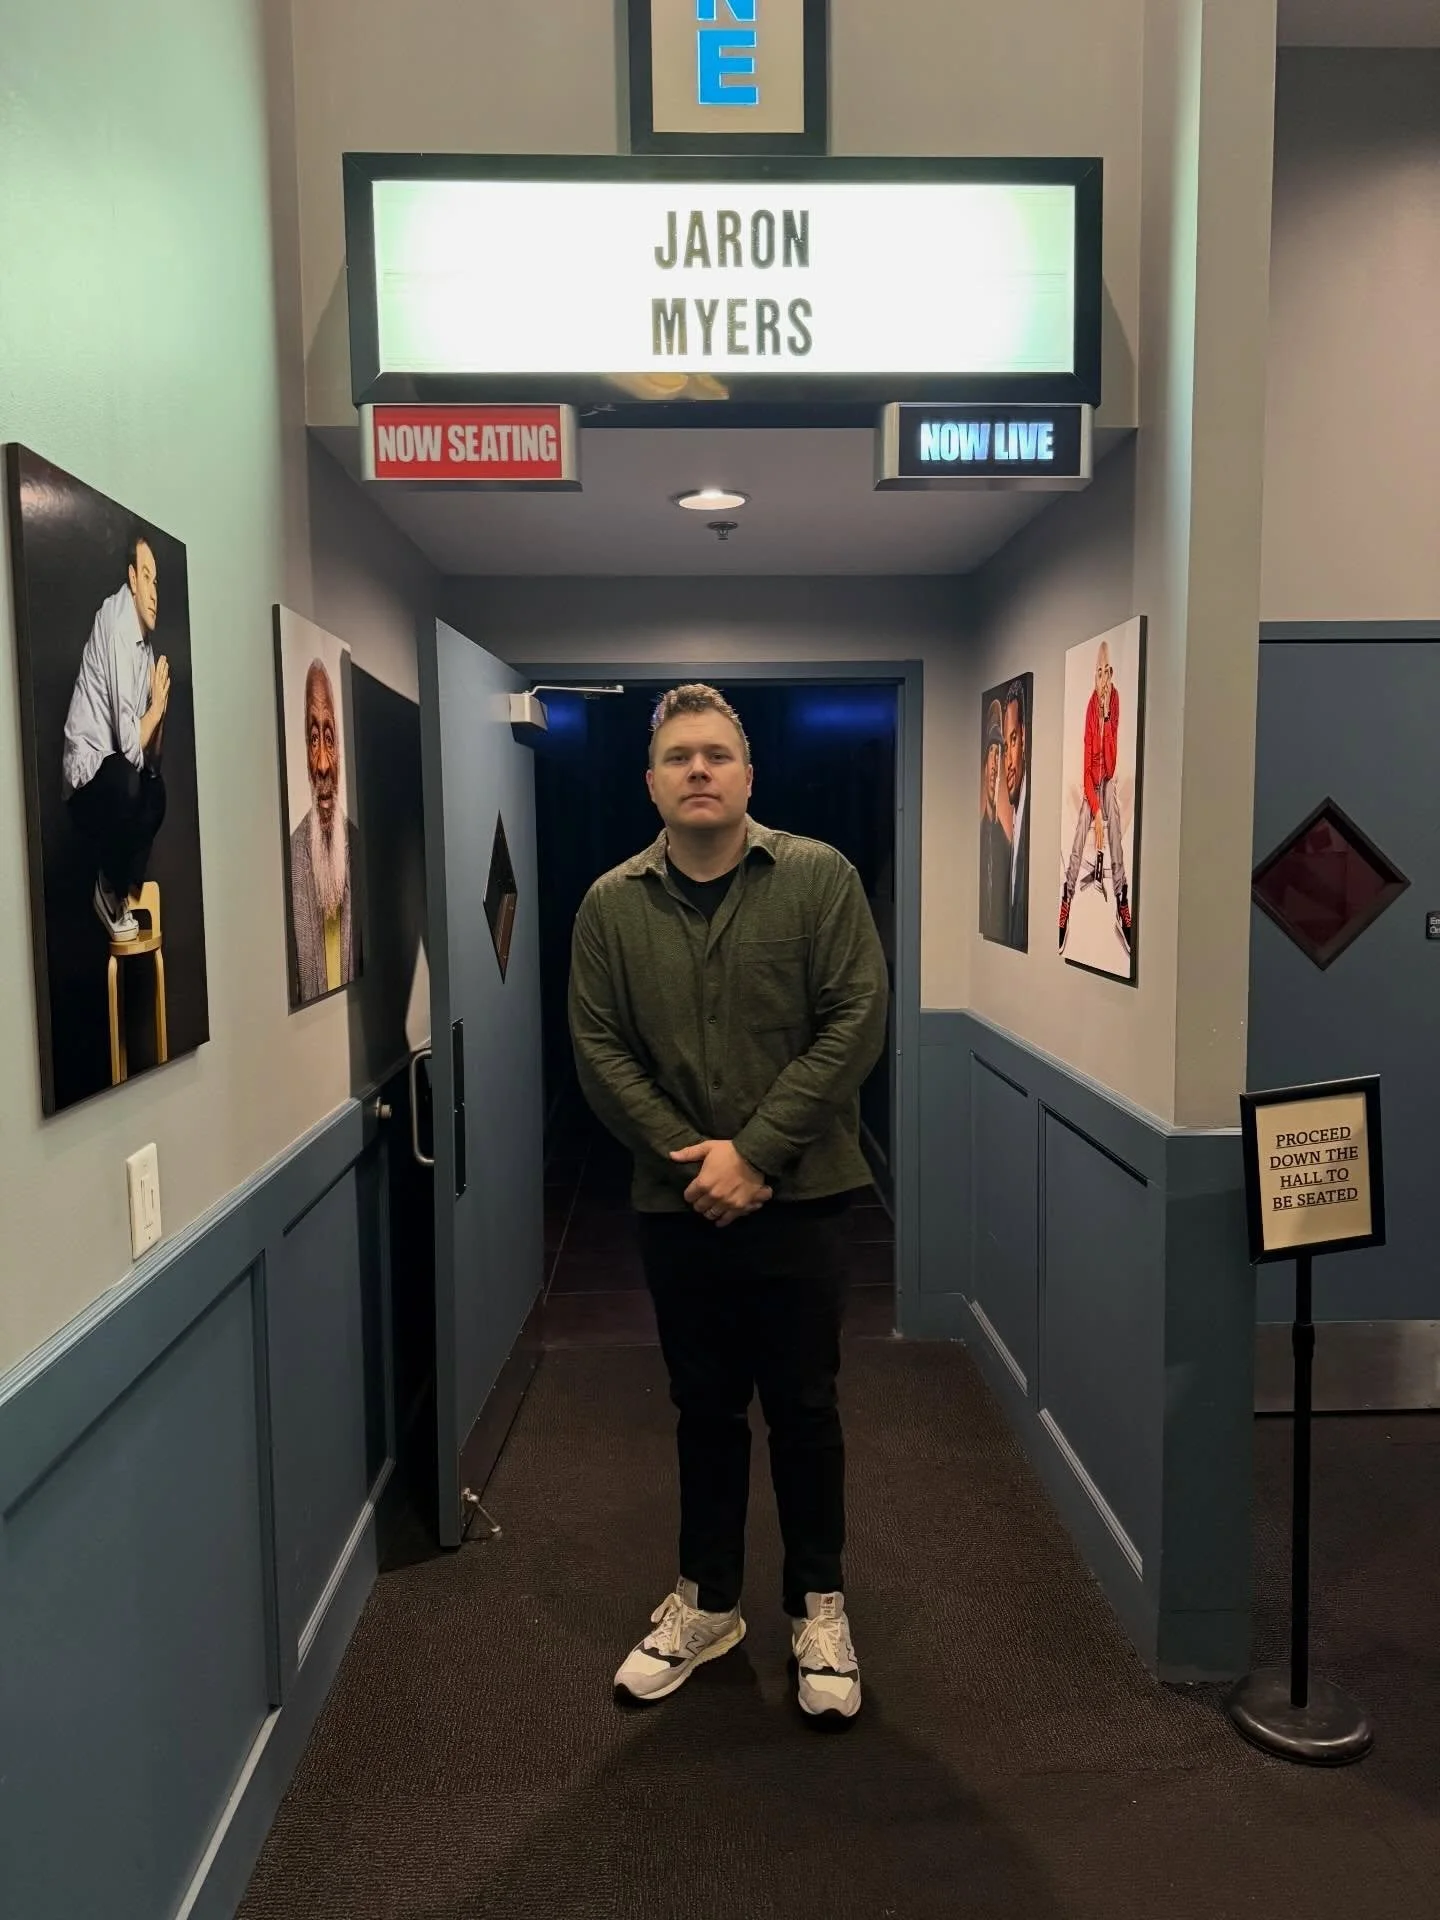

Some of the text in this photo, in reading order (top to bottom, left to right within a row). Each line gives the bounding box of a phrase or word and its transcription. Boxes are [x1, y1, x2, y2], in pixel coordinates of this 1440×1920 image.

[696, 0, 759, 105] E
[654, 209, 810, 270] JARON
[652, 298, 813, 357] MYERS
[377, 424, 558, 462] NOW SEATING
[920, 423, 1054, 461] NOW LIVE
[1276, 1126, 1351, 1148] PROCEED
[1270, 1146, 1359, 1169] DOWN THE
[1280, 1167, 1349, 1189] HALL TO
[1272, 1187, 1358, 1210] BE SEATED
